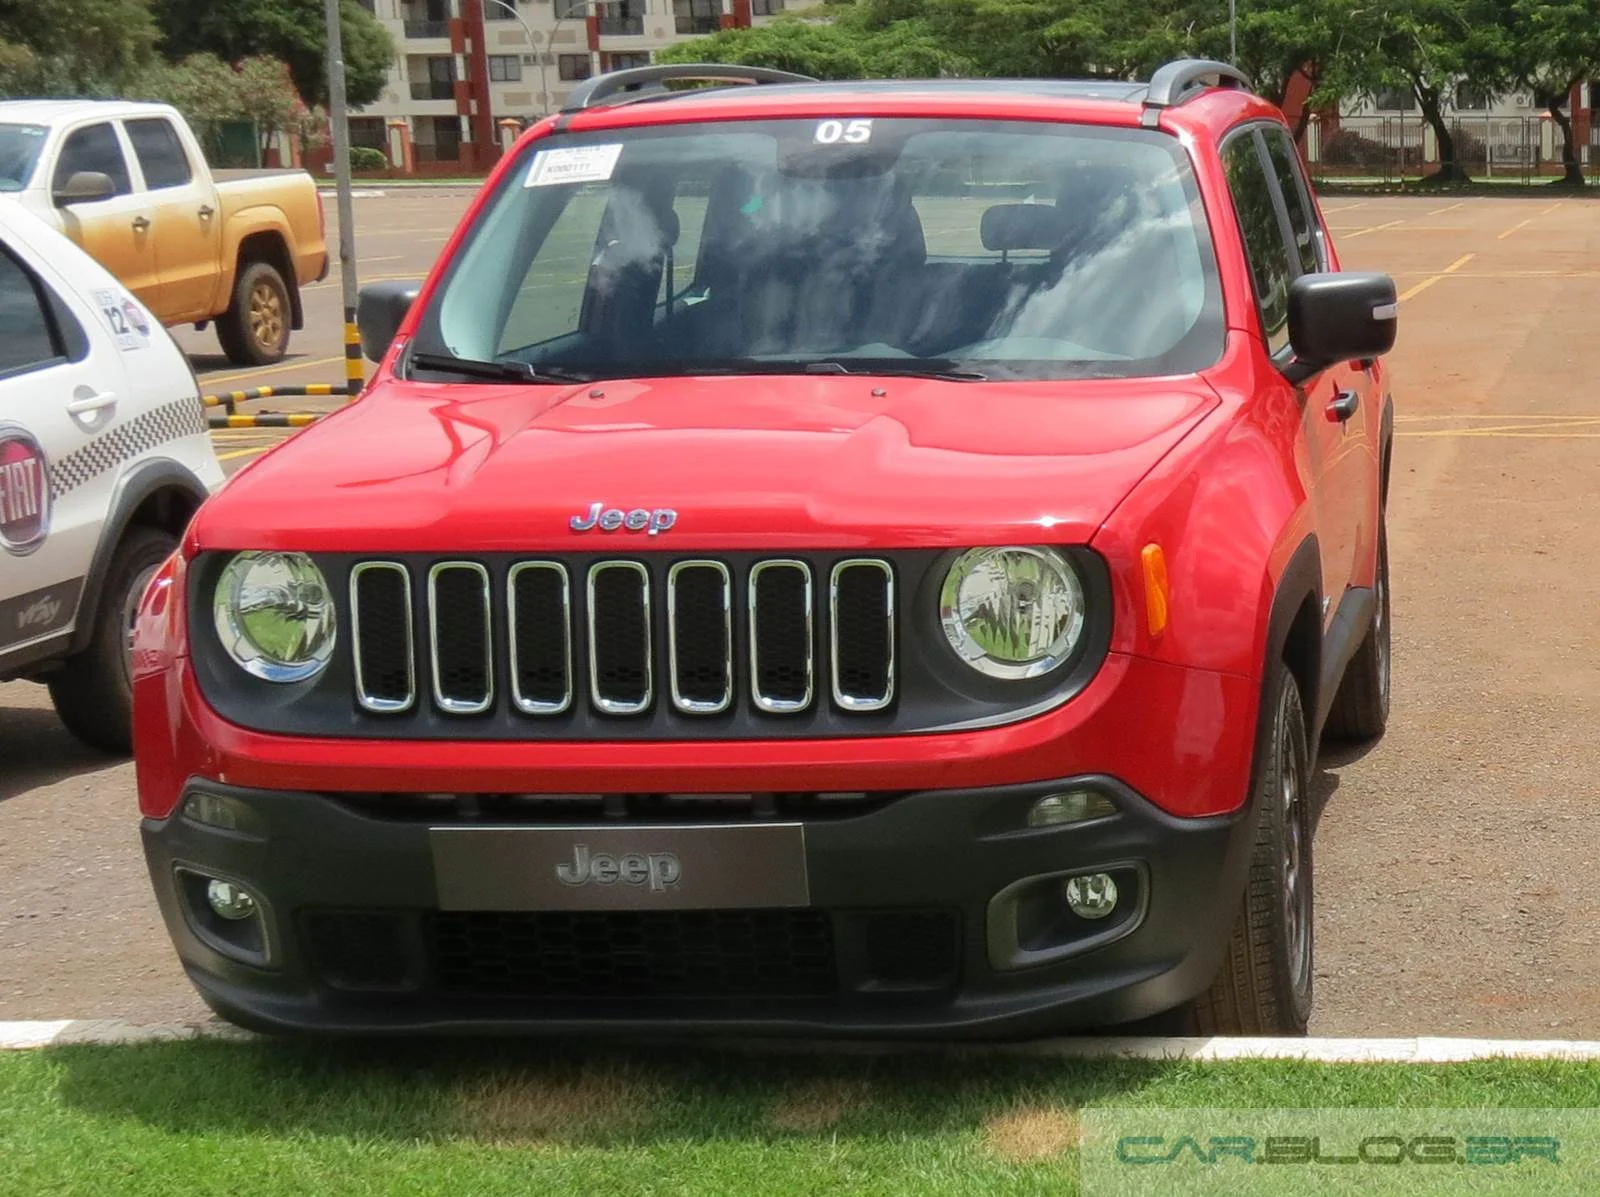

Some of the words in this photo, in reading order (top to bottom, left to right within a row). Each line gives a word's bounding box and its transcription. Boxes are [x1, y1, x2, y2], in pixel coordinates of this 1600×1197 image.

[815, 119, 872, 144] 05
[569, 502, 678, 535] Jeep
[555, 844, 682, 892] Jeep
